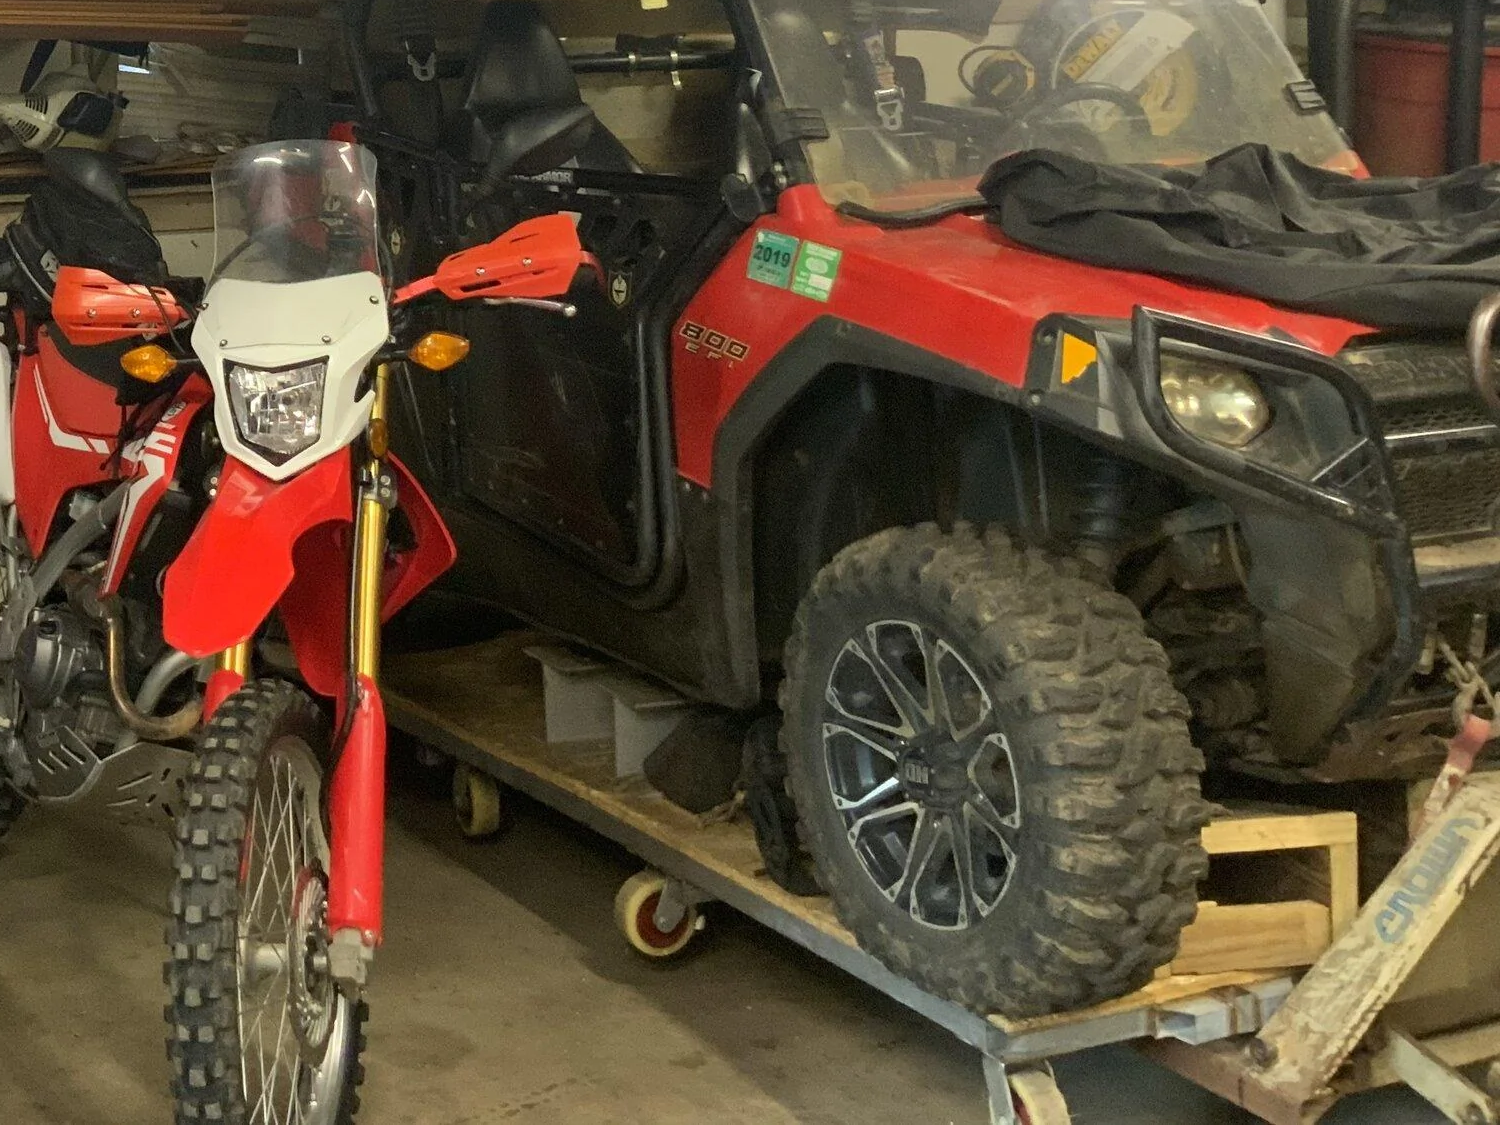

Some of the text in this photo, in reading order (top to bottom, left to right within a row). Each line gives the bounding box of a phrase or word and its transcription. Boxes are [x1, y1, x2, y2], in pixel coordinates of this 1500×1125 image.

[752, 244, 791, 269] 2019
[680, 320, 751, 363] 800
[686, 341, 734, 368] EFI
